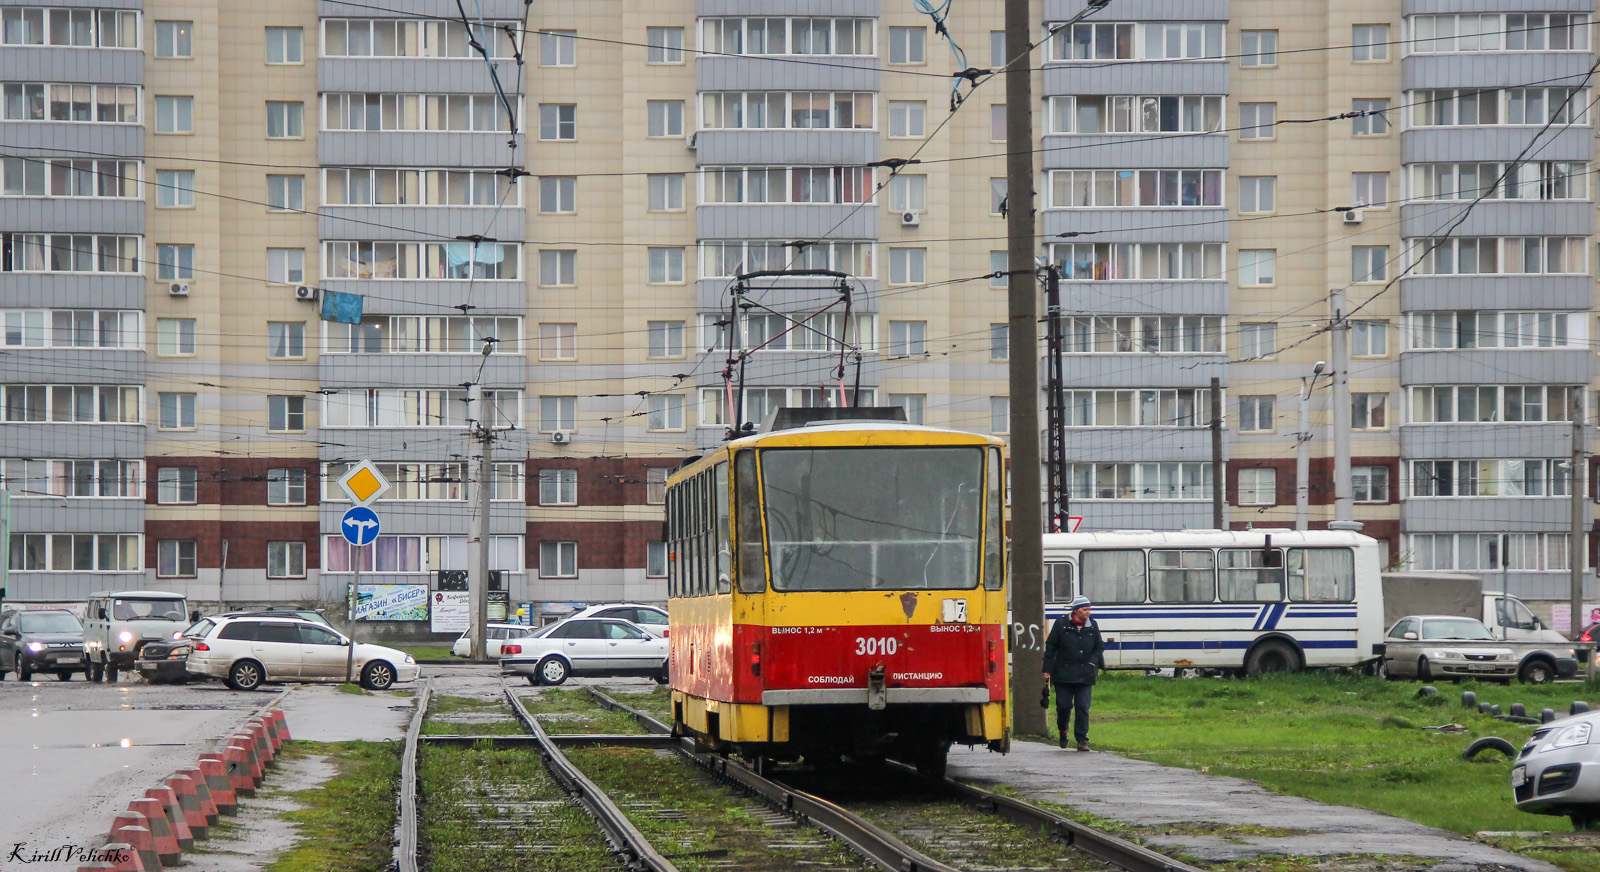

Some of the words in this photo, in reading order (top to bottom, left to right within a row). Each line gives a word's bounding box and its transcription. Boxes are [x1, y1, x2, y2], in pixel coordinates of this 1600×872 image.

[391, 588, 426, 603] «БИСЕР»
[957, 602, 965, 619] 7
[930, 625, 961, 633] ВЫНОС
[962, 625, 973, 633] 1,2
[855, 637, 897, 655] 3010
[808, 675, 855, 684] СОБЛЮДАЙ
[892, 672, 943, 681] ДИСТАНЦИЮ
